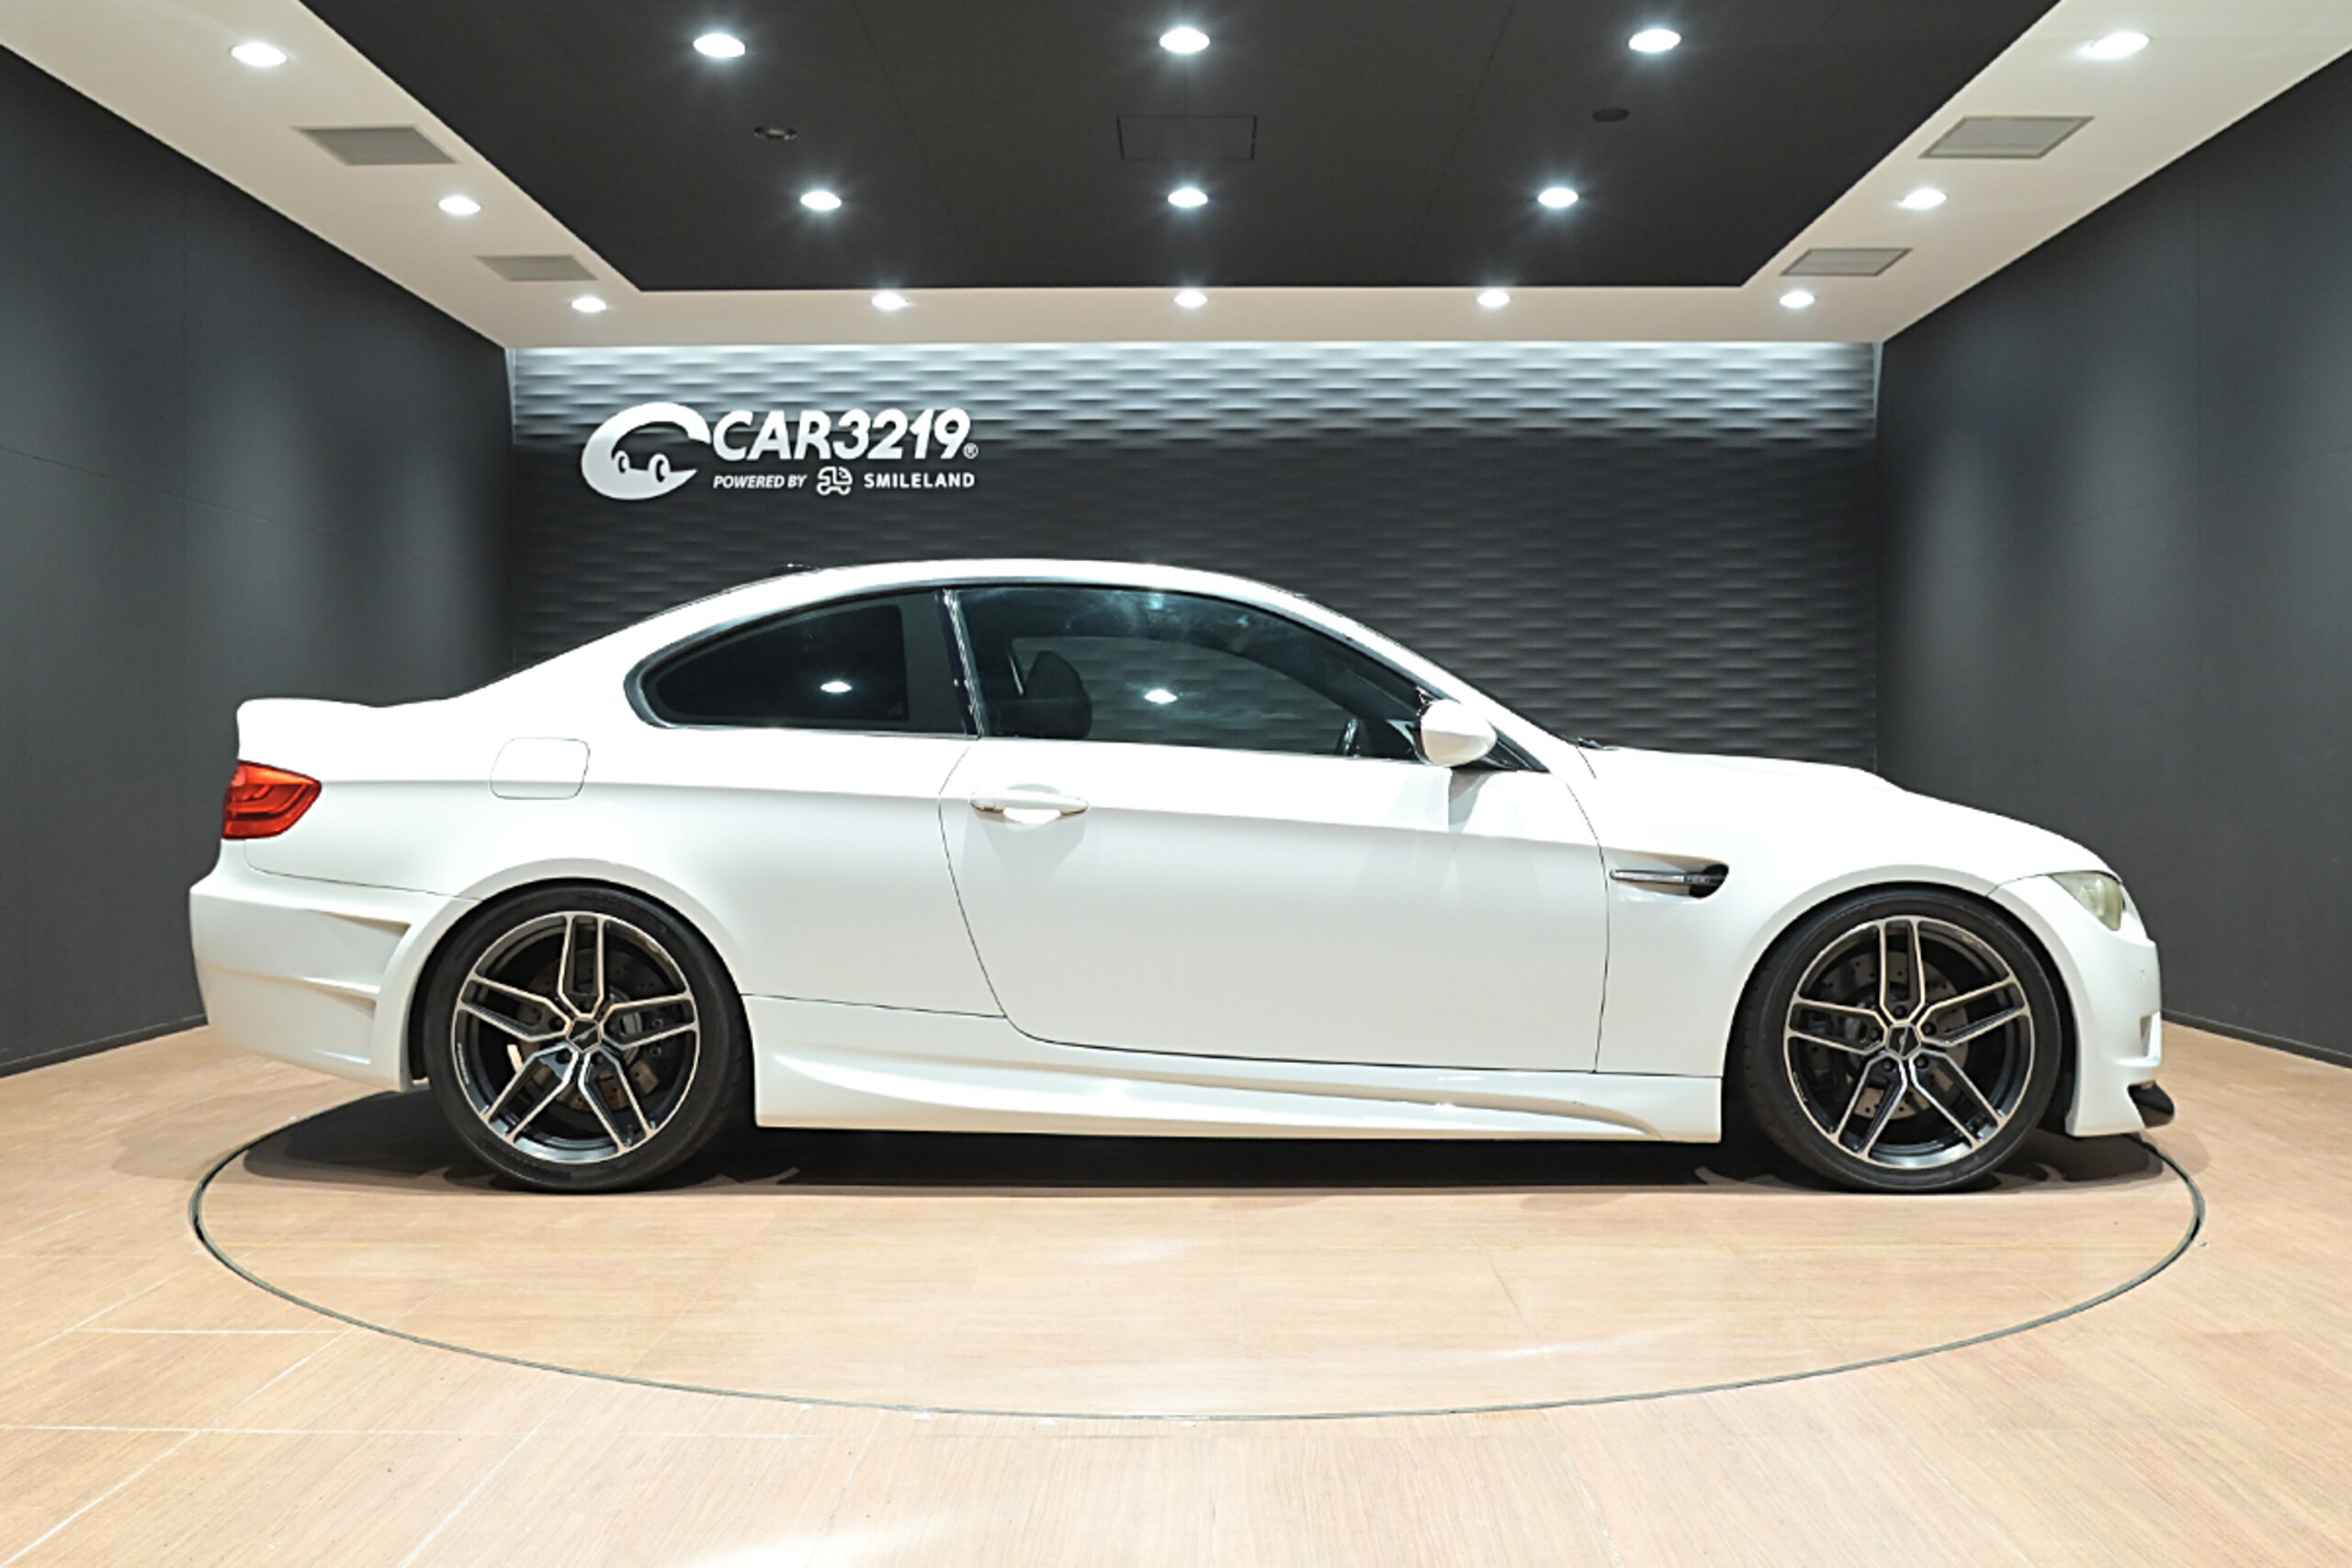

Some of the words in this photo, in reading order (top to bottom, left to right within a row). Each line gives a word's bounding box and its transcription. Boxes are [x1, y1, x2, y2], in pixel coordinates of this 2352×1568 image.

[712, 474, 785, 489] POWERED
[786, 474, 808, 489] BY
[864, 472, 976, 489] SMILELAND
